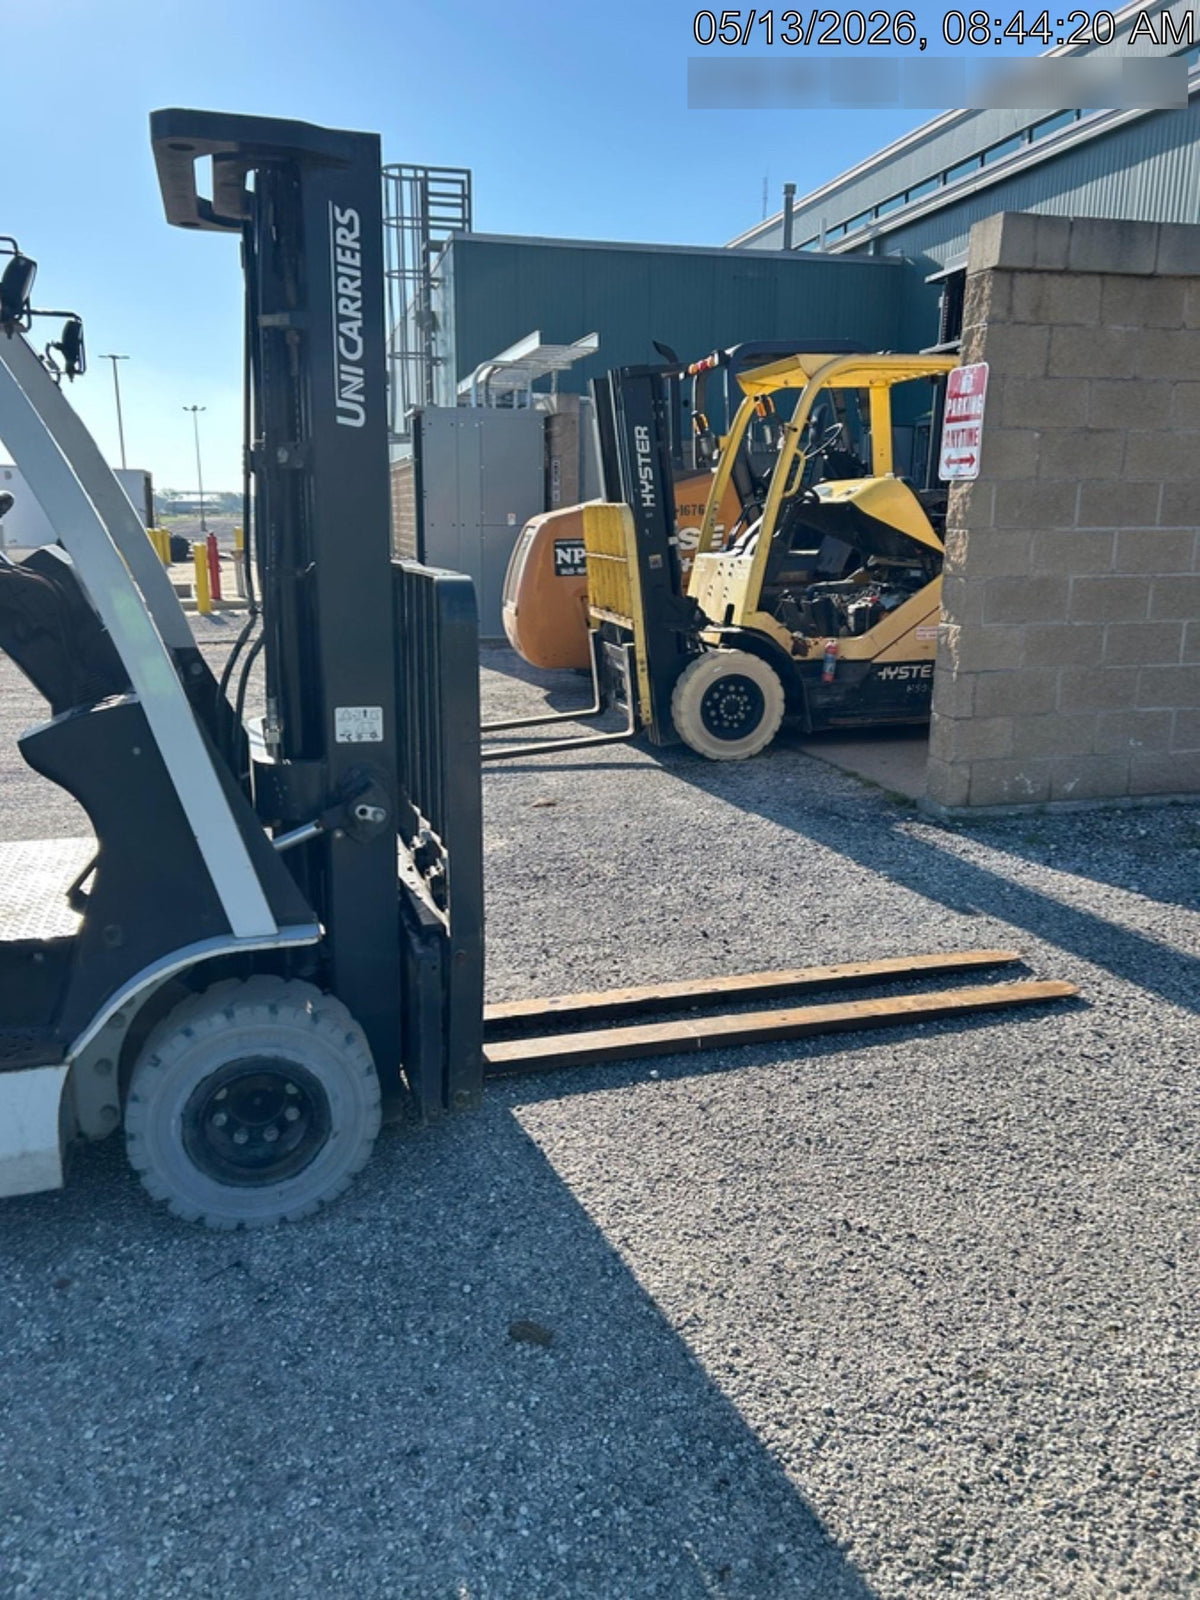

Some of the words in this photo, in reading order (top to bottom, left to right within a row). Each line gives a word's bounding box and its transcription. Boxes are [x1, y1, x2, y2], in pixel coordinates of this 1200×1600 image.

[333, 203, 366, 428] UNICARRIERS
[945, 427, 980, 449] ANYTIME
[634, 425, 657, 508] HYSTER
[555, 548, 586, 565] NP
[877, 664, 933, 680] HYSTE
